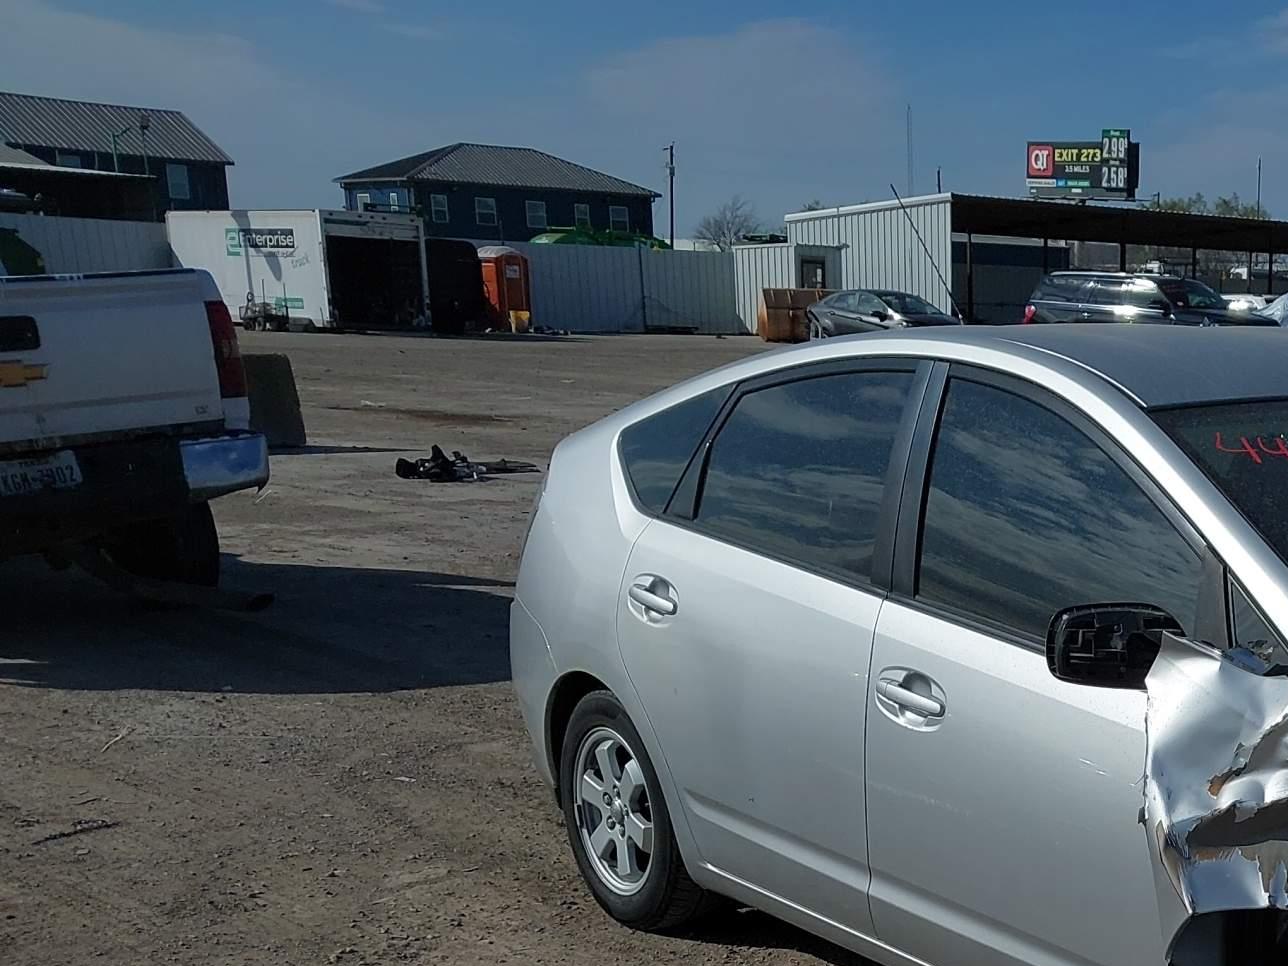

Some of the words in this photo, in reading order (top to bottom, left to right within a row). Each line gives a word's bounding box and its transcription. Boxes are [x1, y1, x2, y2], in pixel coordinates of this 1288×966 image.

[1031, 149, 1049, 171] QT
[1055, 149, 1078, 161] EXIT
[1080, 149, 1101, 161] 273
[1074, 165, 1090, 173] MILES
